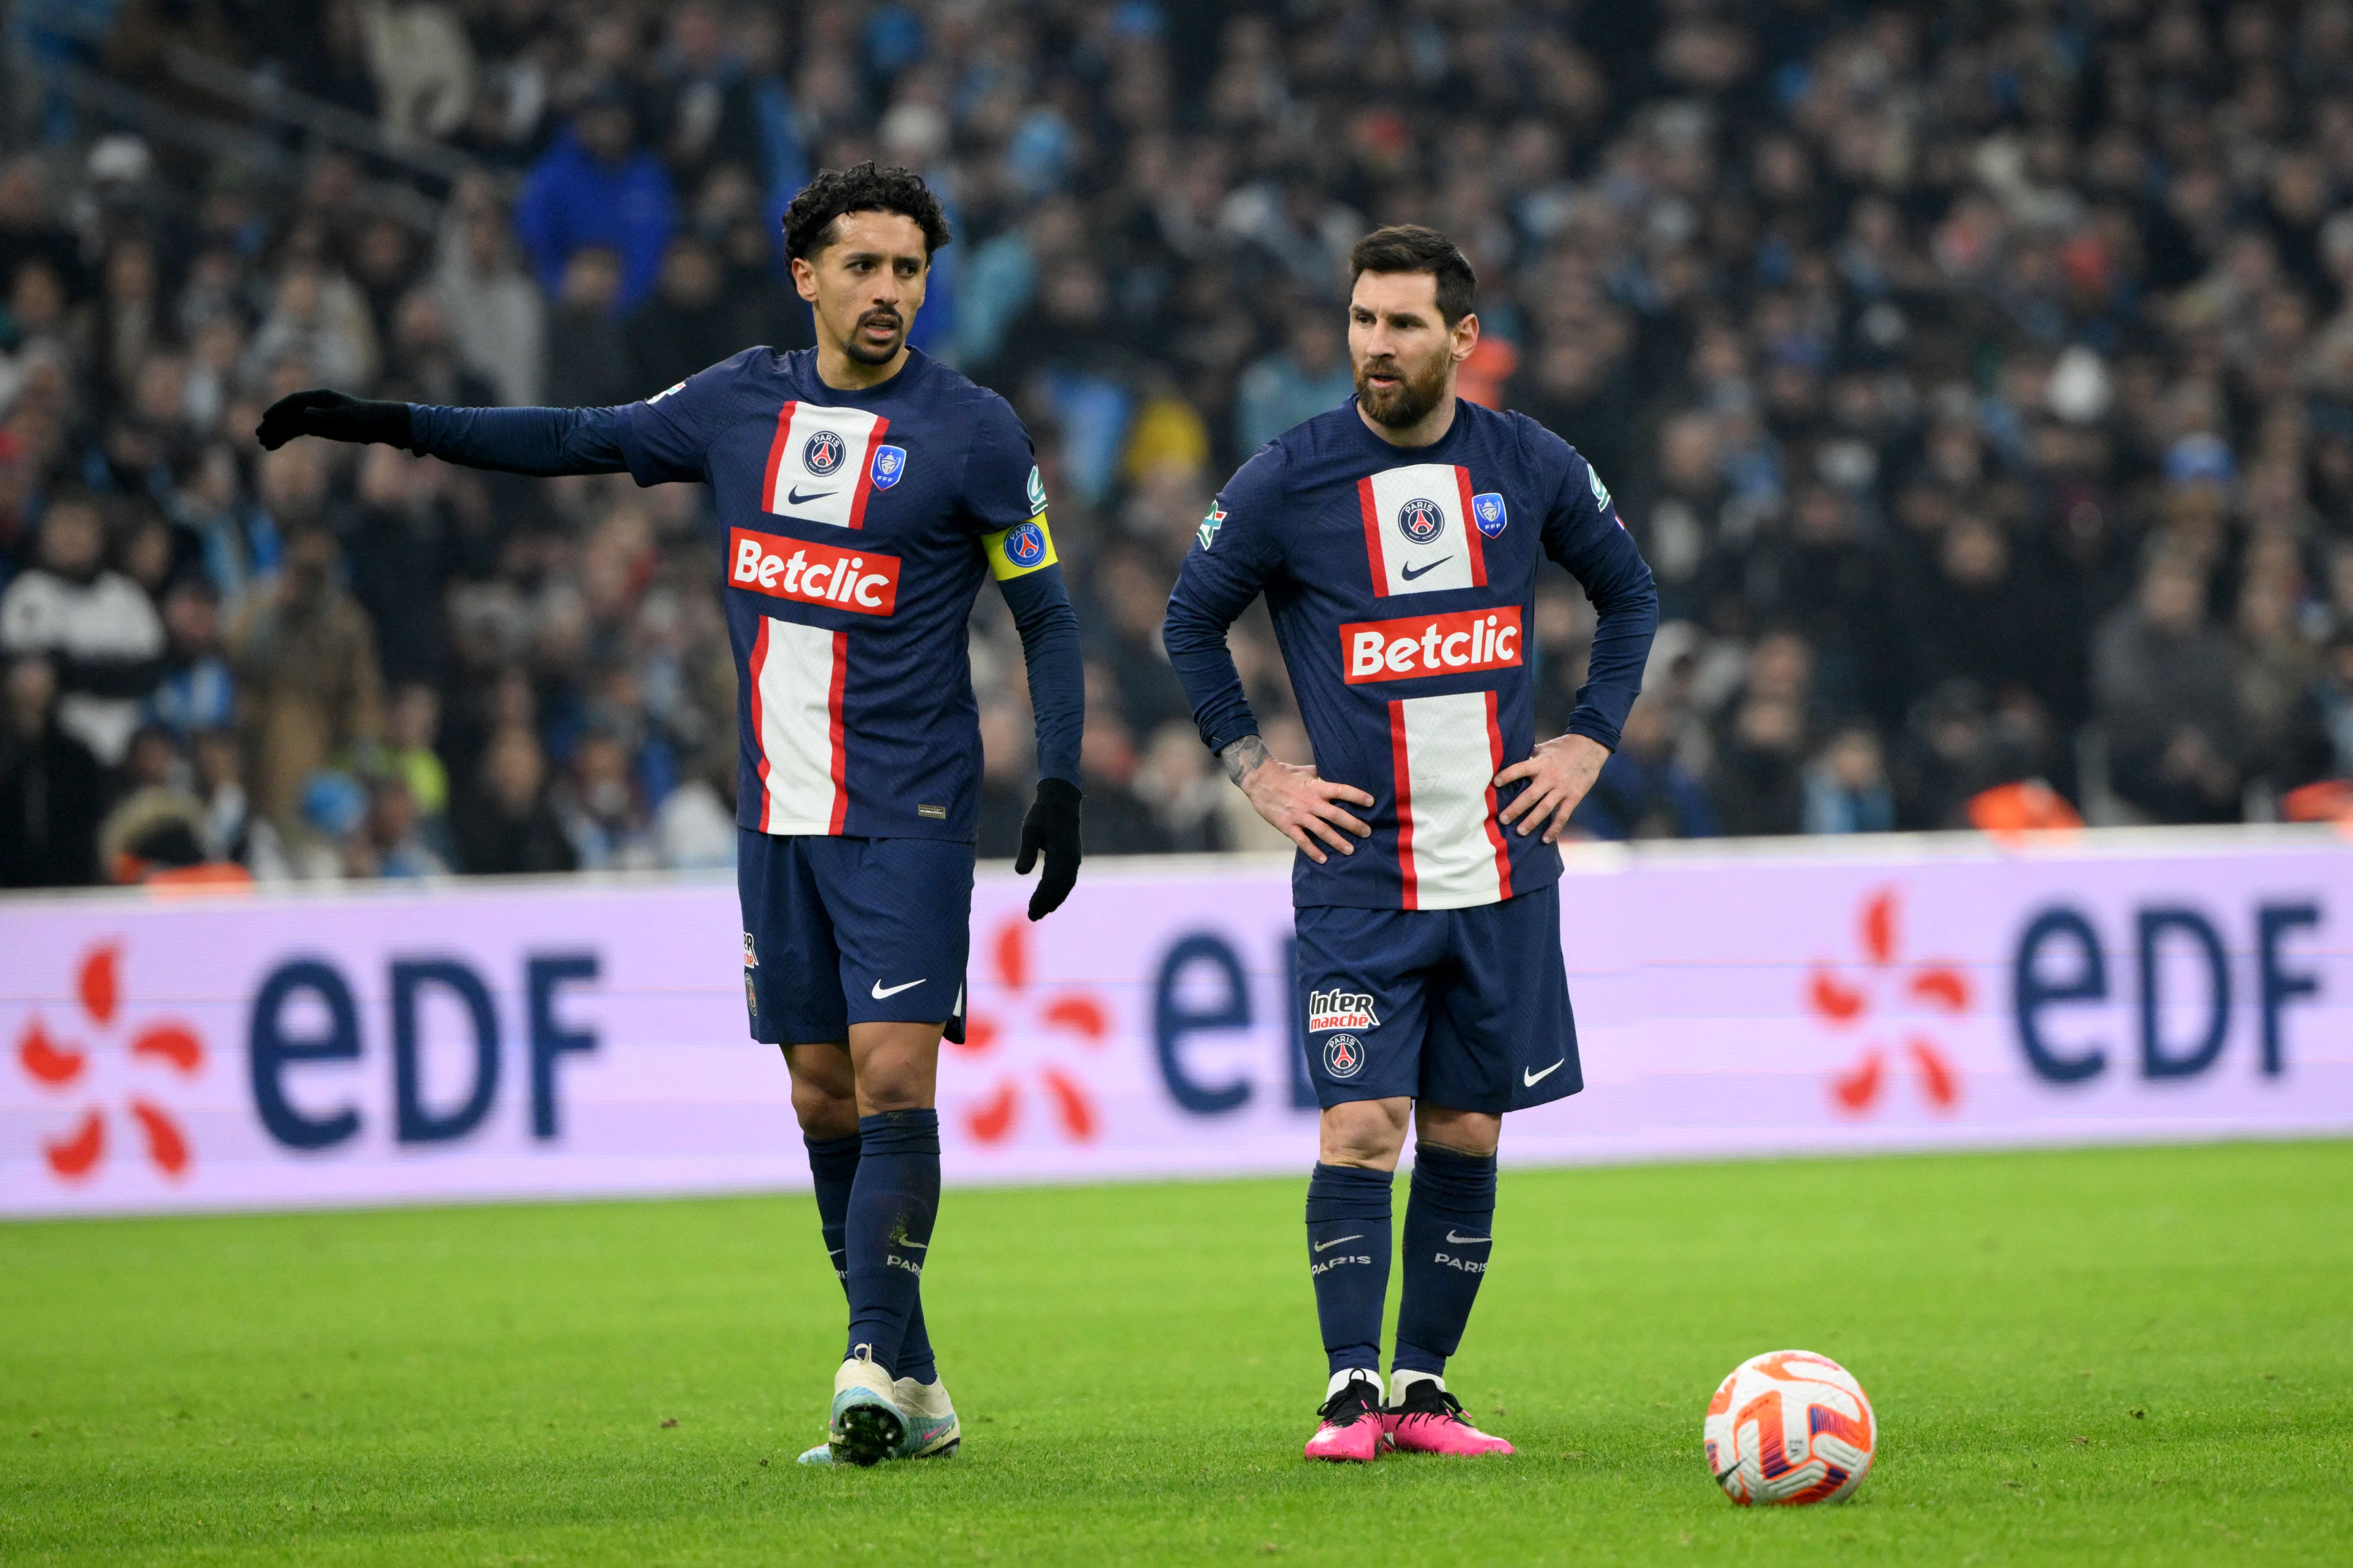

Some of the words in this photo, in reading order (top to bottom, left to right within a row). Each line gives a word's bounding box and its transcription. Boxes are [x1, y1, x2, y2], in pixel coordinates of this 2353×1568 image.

[814, 434, 840, 447] PARIS
[1405, 501, 1433, 513] PARIS
[1010, 525, 1035, 540] PARIS
[734, 539, 889, 607] Betclic
[1352, 615, 1517, 676] Betclic
[1329, 1036, 1355, 1048] PARIS
[1312, 1256, 1371, 1277] PARIS
[1435, 1253, 1488, 1273] PARIS
